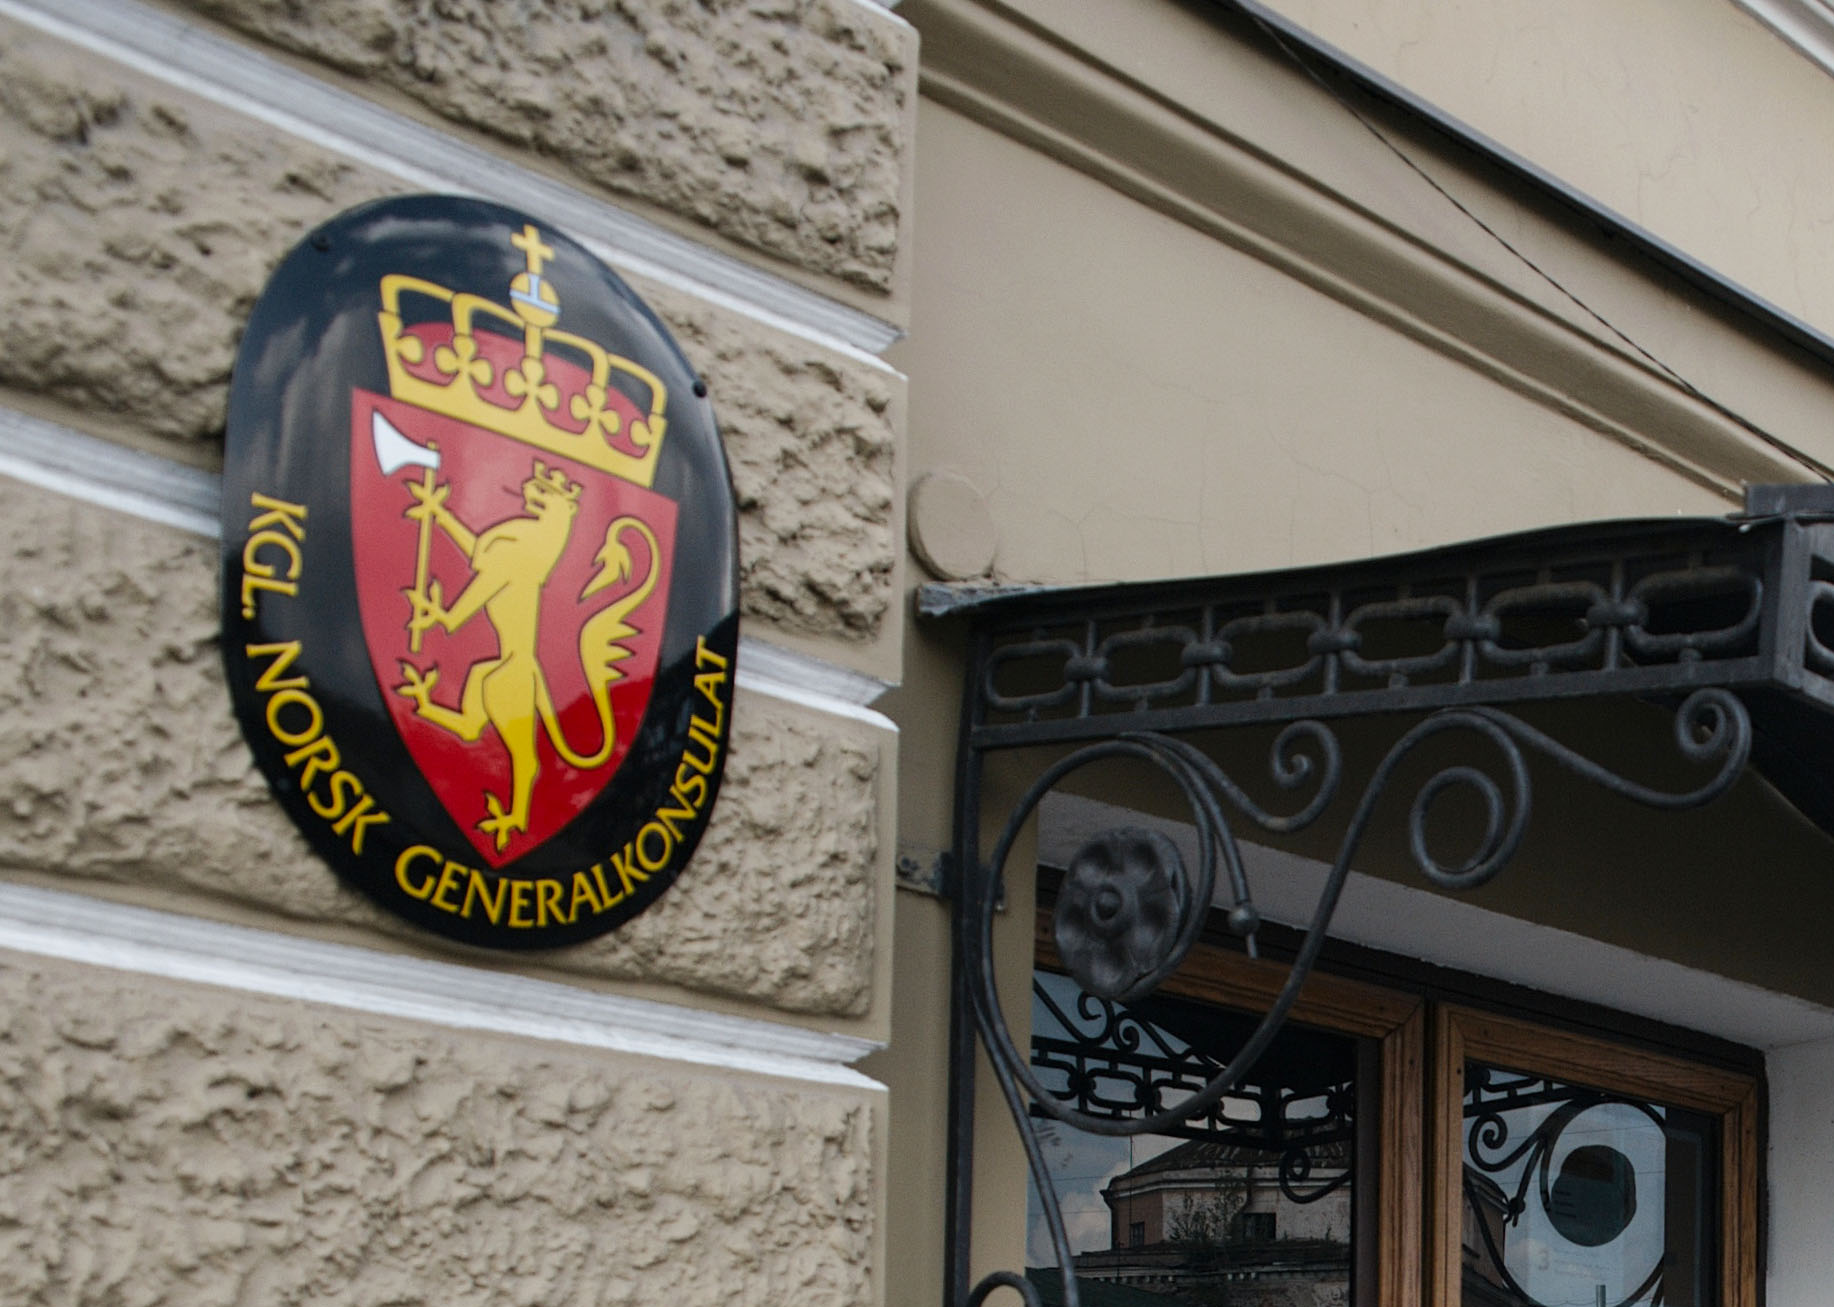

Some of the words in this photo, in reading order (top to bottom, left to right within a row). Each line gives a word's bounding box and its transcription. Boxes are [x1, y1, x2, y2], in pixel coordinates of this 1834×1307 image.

[241, 490, 308, 619] KGL.
[246, 640, 391, 856] NORSK
[394, 635, 728, 928] GENERALKONSULAT
